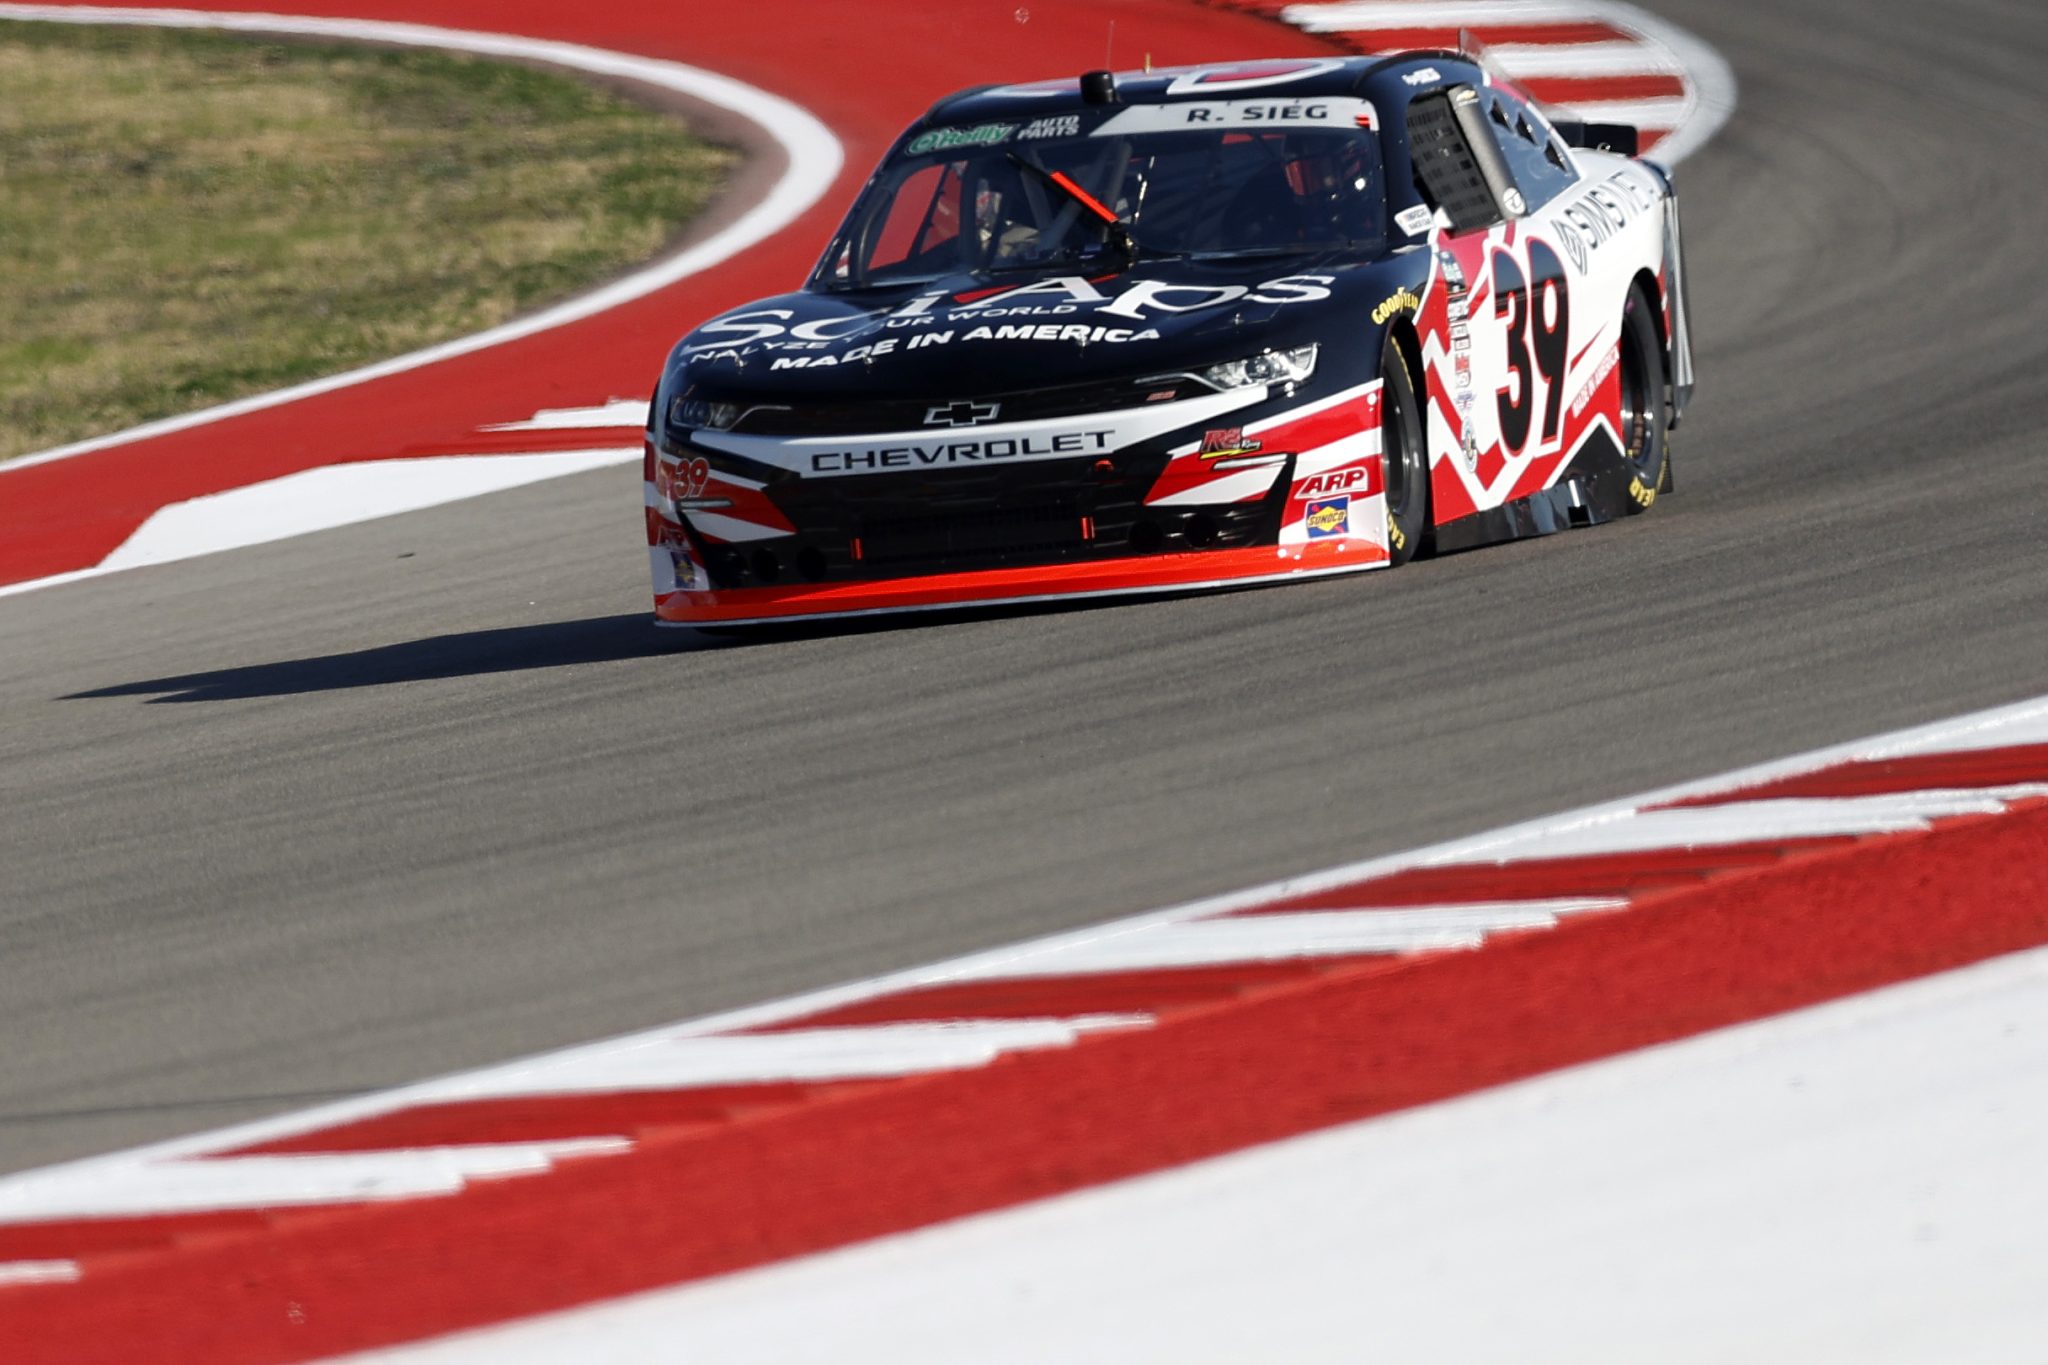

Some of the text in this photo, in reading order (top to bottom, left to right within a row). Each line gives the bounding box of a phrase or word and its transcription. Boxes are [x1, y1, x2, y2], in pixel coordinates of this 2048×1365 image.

[1030, 114, 1080, 129] AUTO
[1186, 105, 1328, 122] R. SIEG
[1016, 126, 1080, 140] PARTS
[949, 304, 1078, 320] WORLD
[770, 324, 1161, 371] MADE IN AMERICA
[1490, 235, 1570, 458] 39
[811, 430, 1116, 471] CHEVROLET
[673, 457, 709, 499] 39
[1301, 469, 1365, 495] ARP
[1307, 511, 1346, 526] SUNOCO
